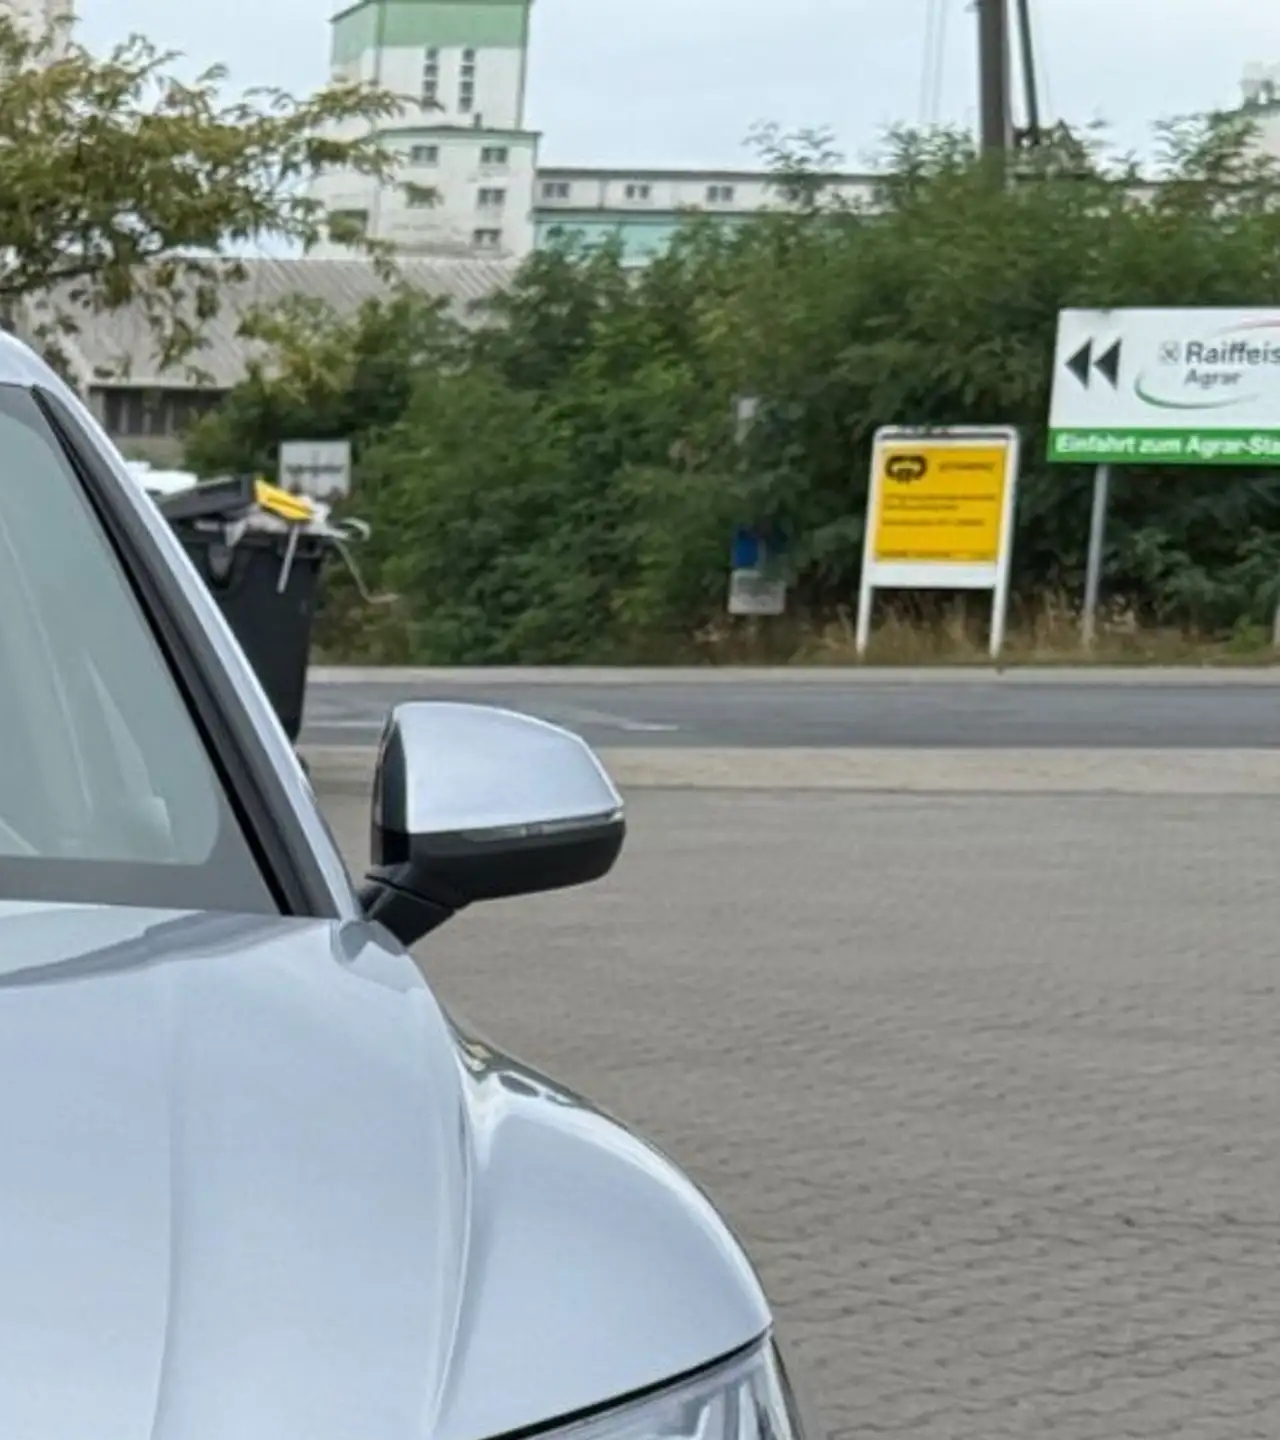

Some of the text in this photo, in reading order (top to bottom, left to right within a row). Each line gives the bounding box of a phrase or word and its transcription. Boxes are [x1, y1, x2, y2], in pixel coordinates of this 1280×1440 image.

[1184, 369, 1242, 389] Agrar
[1055, 434, 1136, 453] Einfahrt
[1139, 438, 1180, 453] zum
